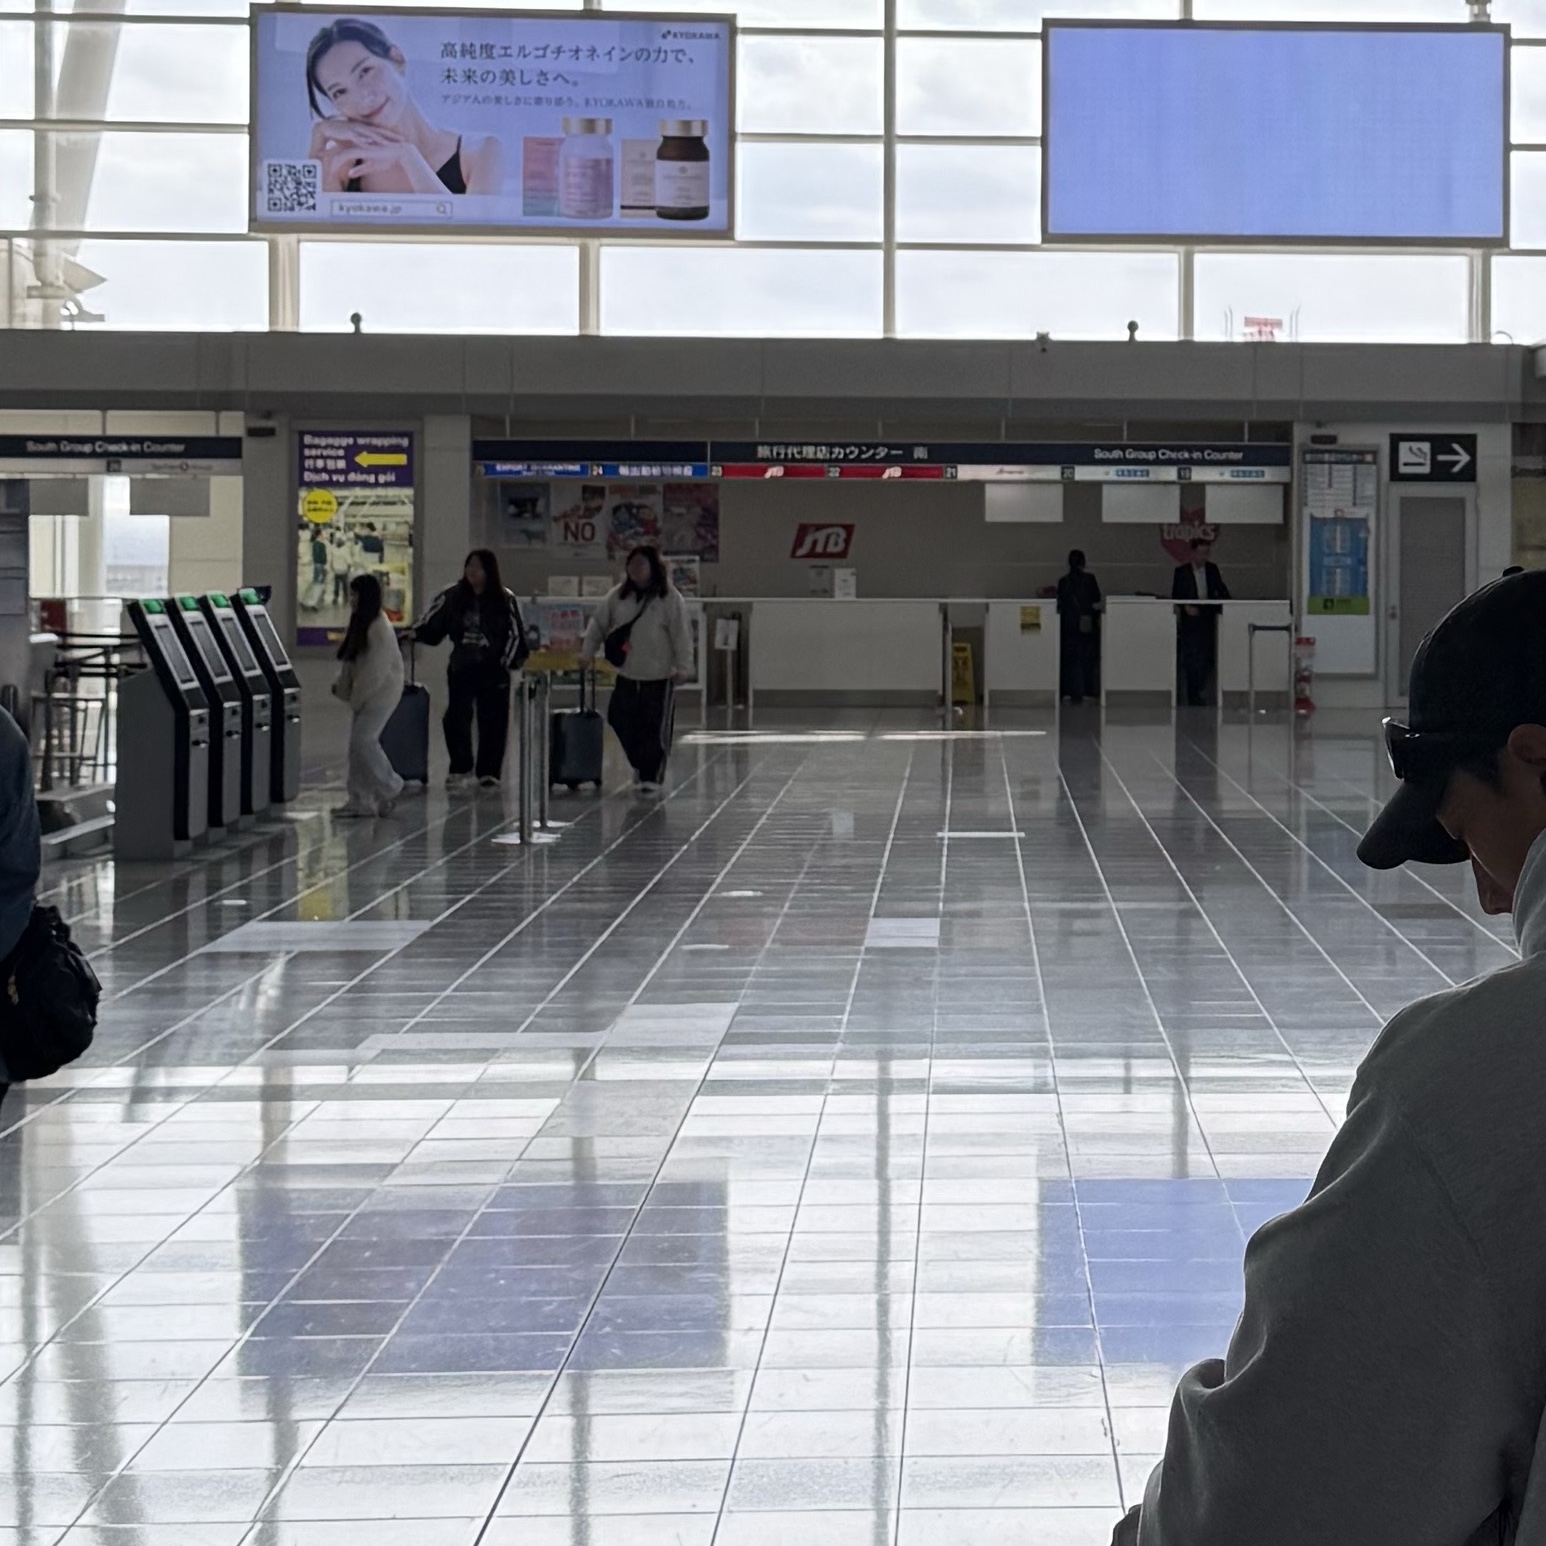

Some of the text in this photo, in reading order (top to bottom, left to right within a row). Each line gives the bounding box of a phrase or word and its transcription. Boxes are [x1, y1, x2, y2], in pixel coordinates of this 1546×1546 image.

[441, 41, 695, 64] 高純度エルゴチオネインの力で、
[441, 68, 580, 87] 未来の美しさへ。
[756, 445, 904, 460] 旅行代理店カウンター
[1094, 448, 1243, 461] South Group Check-in Counter
[563, 521, 596, 542] NO
[795, 526, 848, 556] JTB
